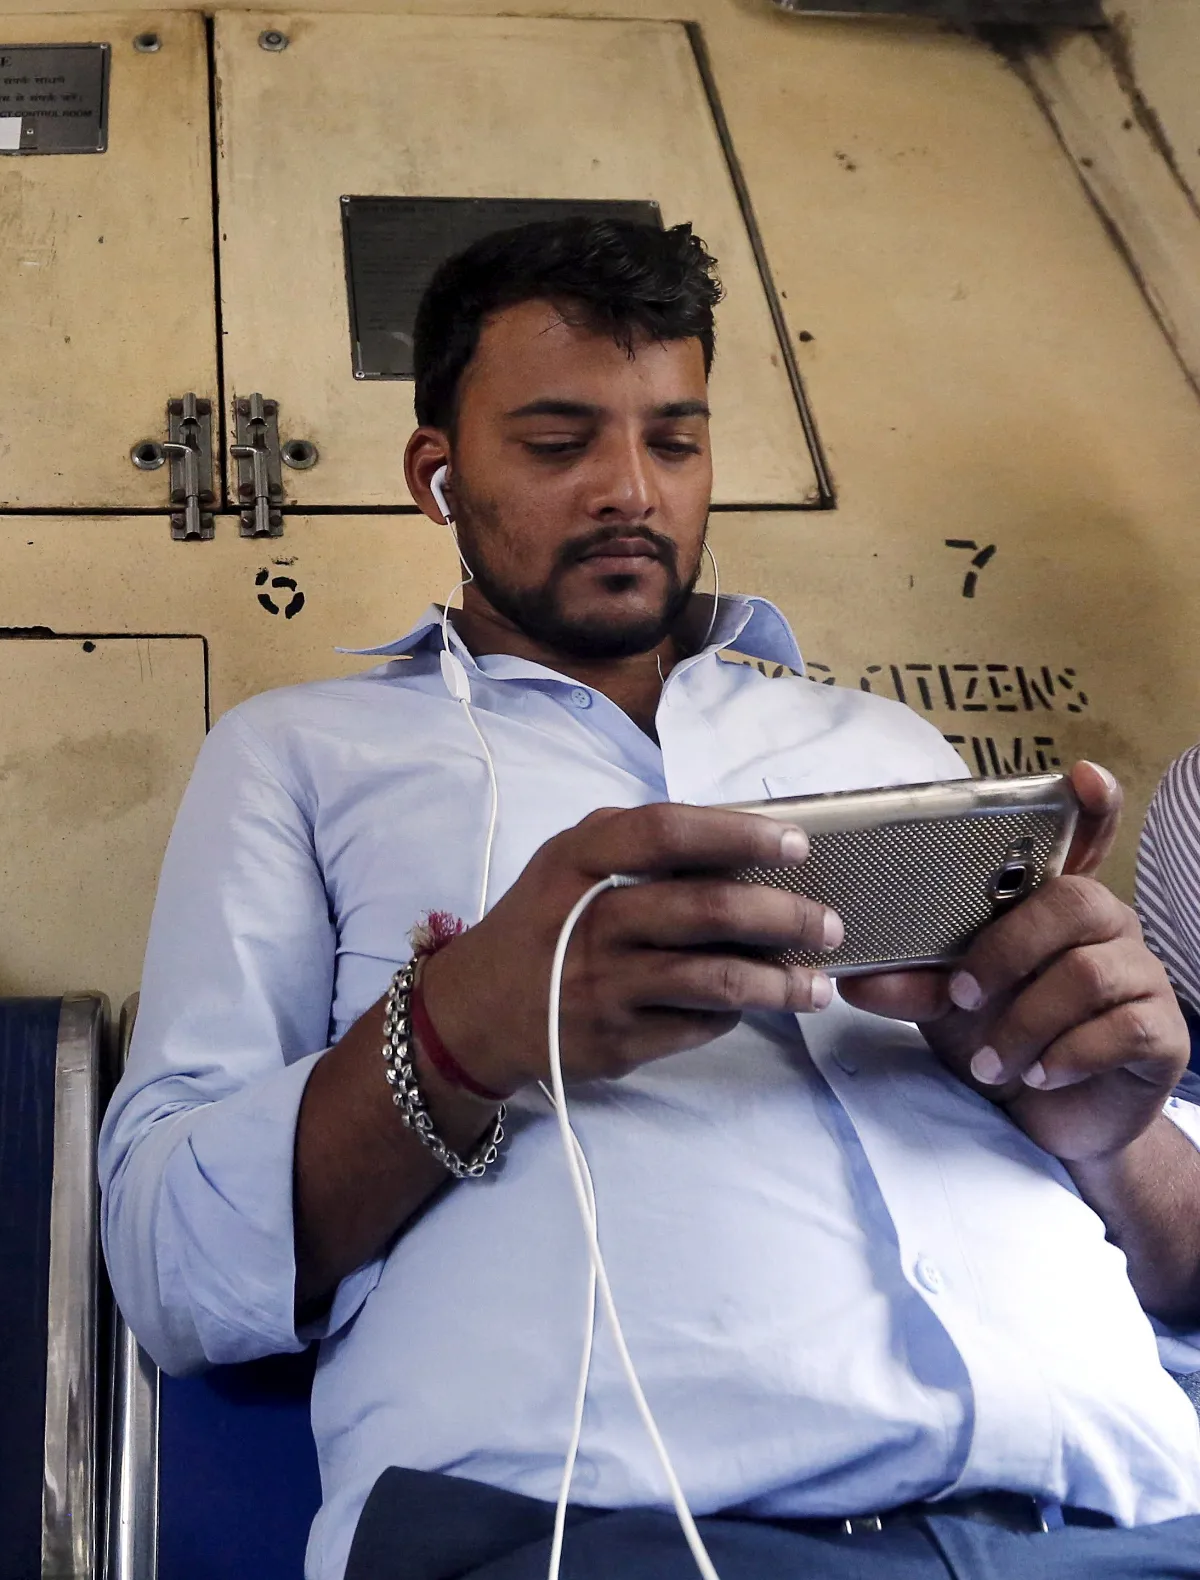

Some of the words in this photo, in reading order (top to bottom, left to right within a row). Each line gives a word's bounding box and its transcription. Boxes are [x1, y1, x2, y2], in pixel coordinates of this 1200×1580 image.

[14, 110, 62, 118] CONTROL
[255, 556, 305, 619] 6
[945, 539, 996, 598] 7
[860, 664, 1088, 712] CITIZENS
